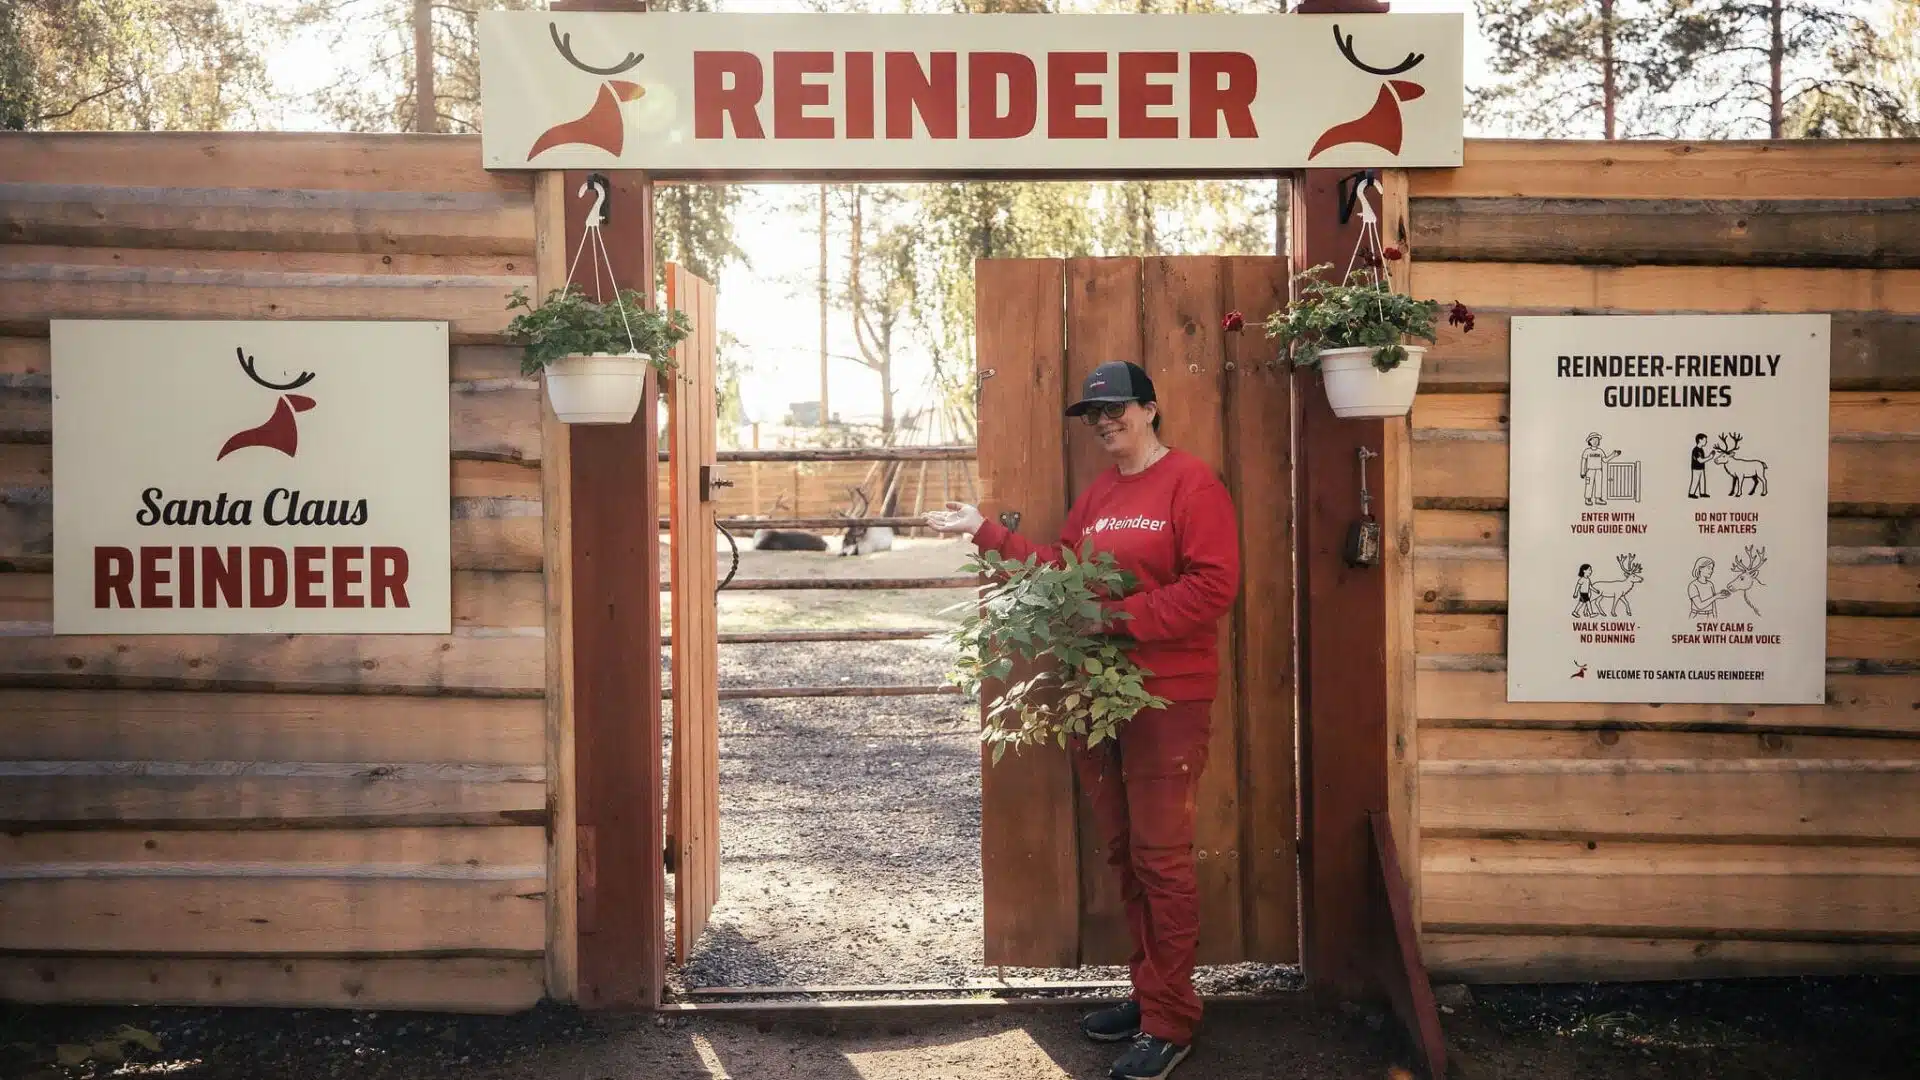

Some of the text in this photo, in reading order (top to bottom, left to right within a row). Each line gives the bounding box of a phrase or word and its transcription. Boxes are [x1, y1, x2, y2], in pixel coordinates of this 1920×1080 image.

[693, 50, 1259, 139] REINDEER
[1557, 355, 1781, 378] REINDEER-FRIENDLY
[1604, 385, 1733, 408] GUIDELINES
[135, 486, 369, 527] Santa Claus
[1581, 512, 1635, 522] ENTER WITH
[1695, 512, 1759, 521] DO NOT TOUCH
[1106, 514, 1167, 532] Reindeer
[1571, 524, 1648, 534] YOUR GUIDE ONLY
[1699, 524, 1757, 534] THE ANTLERS
[94, 546, 411, 608] REINDEER
[1572, 622, 1598, 632] WALK
[1600, 622, 1636, 632] SLOWLY
[1696, 622, 1754, 632] STAY CALM &
[1580, 634, 1636, 643] NO RUNNING
[1671, 634, 1781, 644] SPEAK WITH CALM VOICE
[1597, 669, 1765, 681] WELCOME TO SANTA CLAUS REINDEER!
